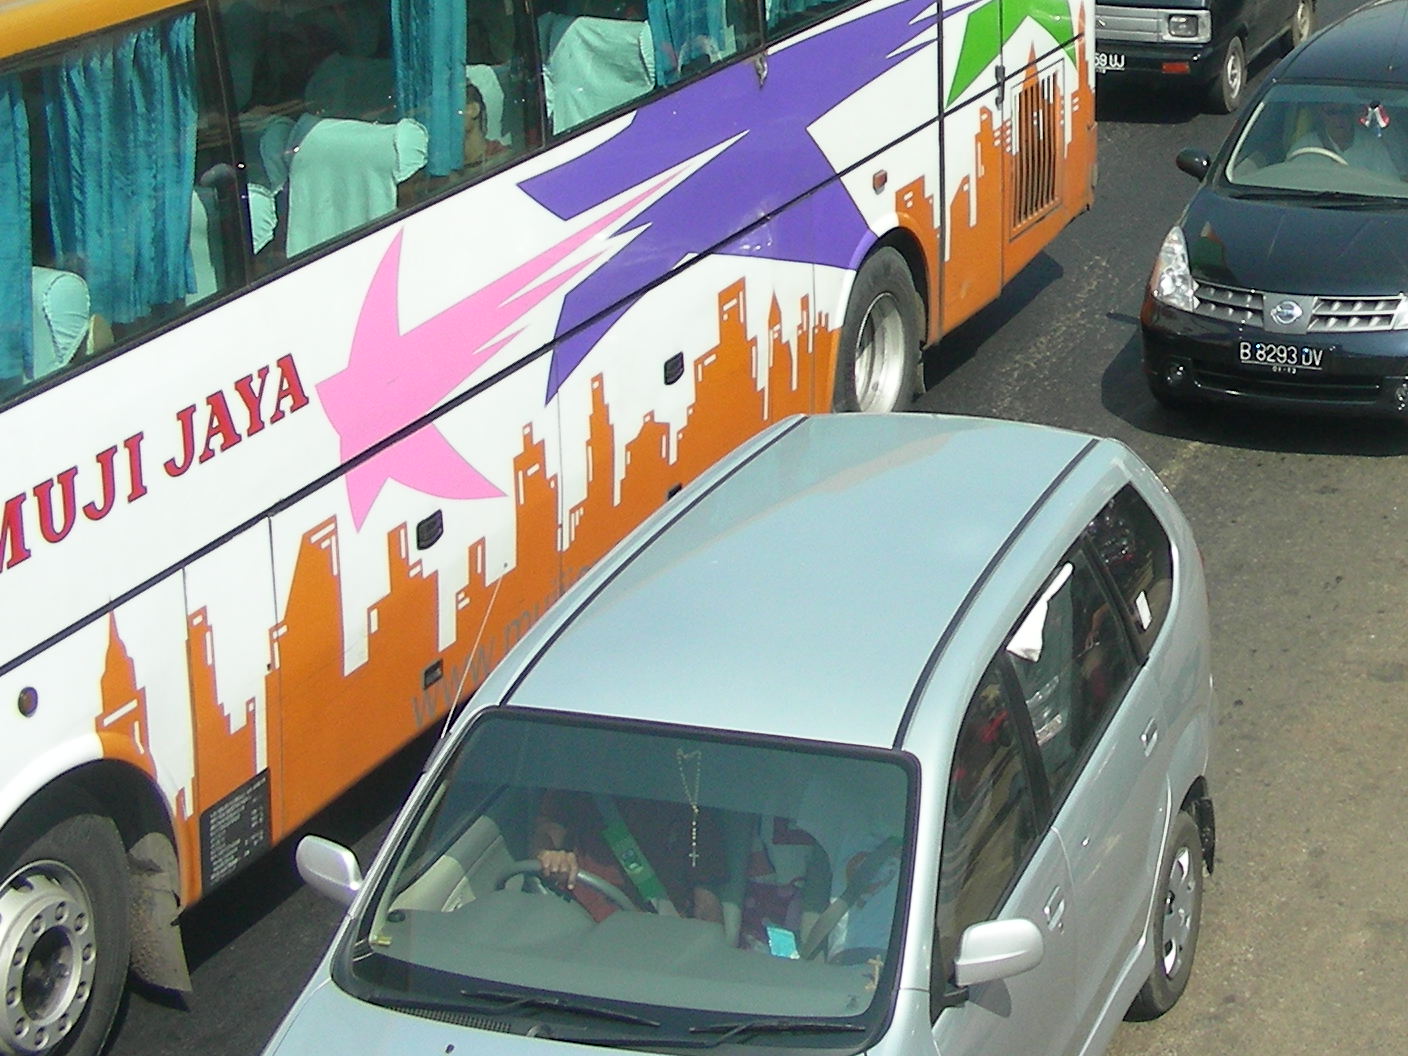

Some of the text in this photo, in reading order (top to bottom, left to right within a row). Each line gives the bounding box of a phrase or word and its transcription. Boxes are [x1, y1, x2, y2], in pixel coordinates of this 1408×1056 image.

[1240, 342, 1251, 360] B
[1256, 343, 1298, 364] 8293
[163, 352, 309, 477] JAYA
